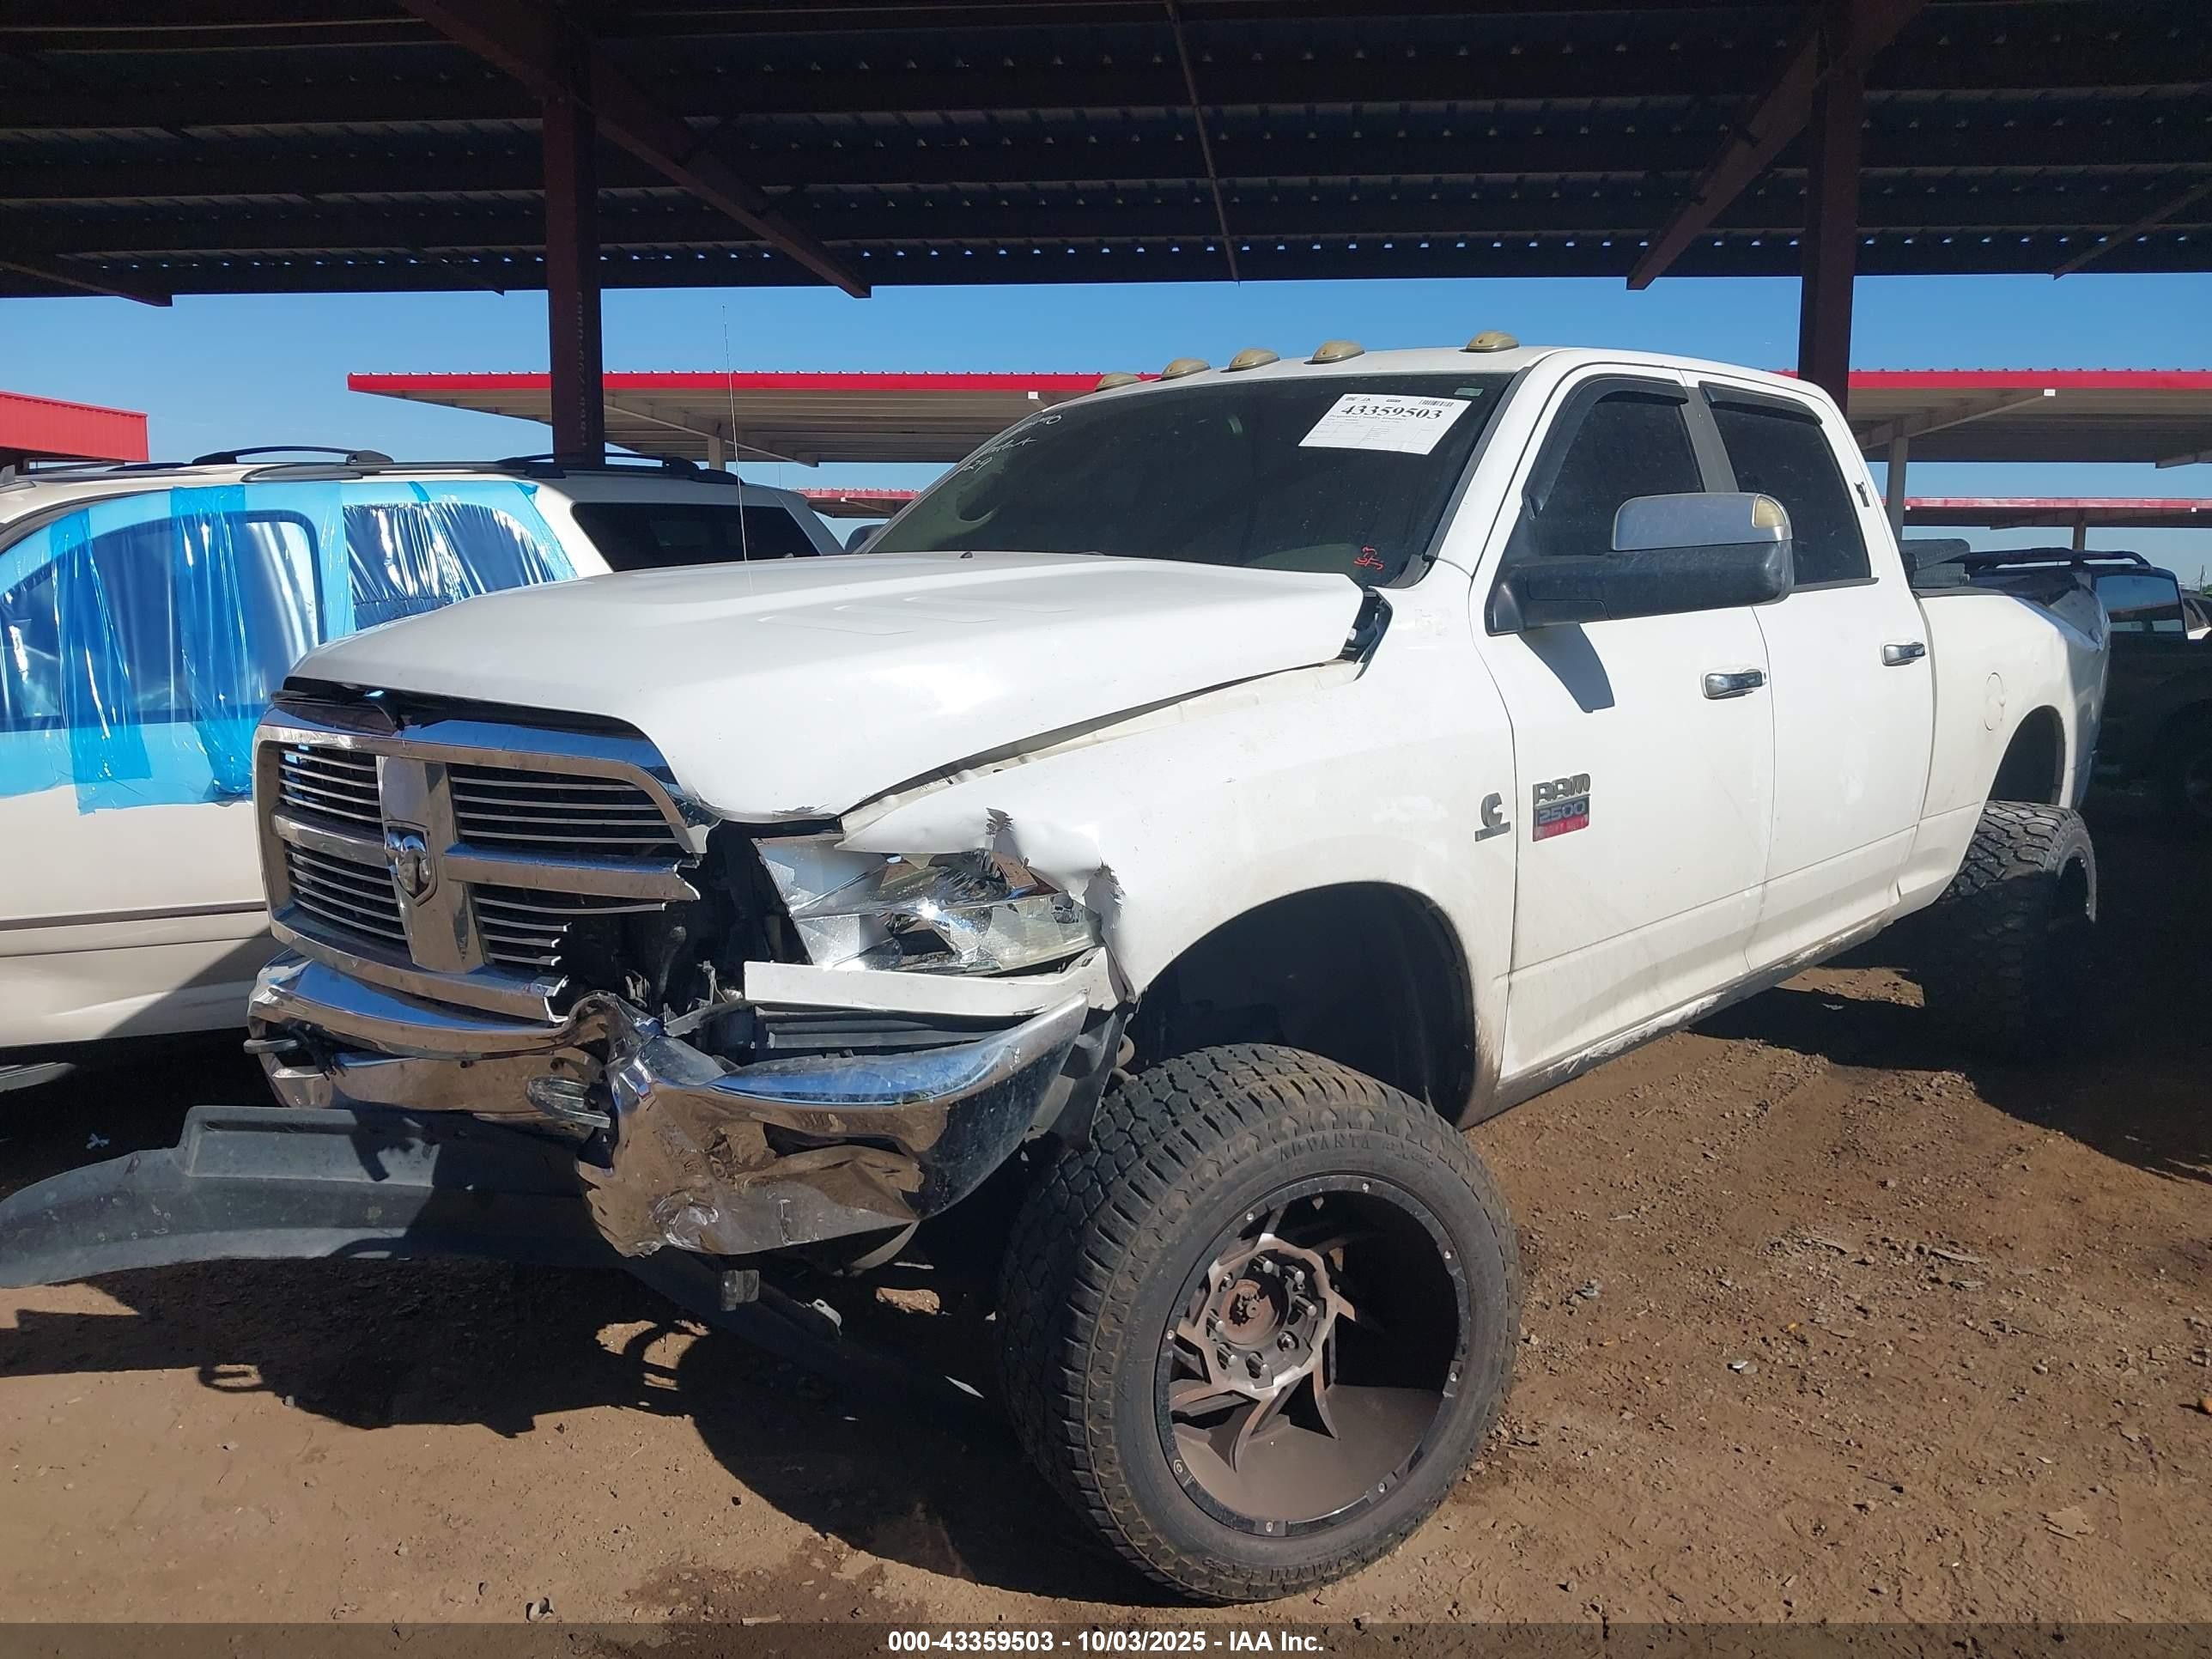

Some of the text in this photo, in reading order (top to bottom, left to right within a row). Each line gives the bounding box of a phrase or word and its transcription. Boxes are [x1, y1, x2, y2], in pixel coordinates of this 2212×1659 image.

[1341, 404, 1443, 419] 43359503
[1533, 773, 1590, 805] RAM
[1540, 800, 1587, 824] 2500
